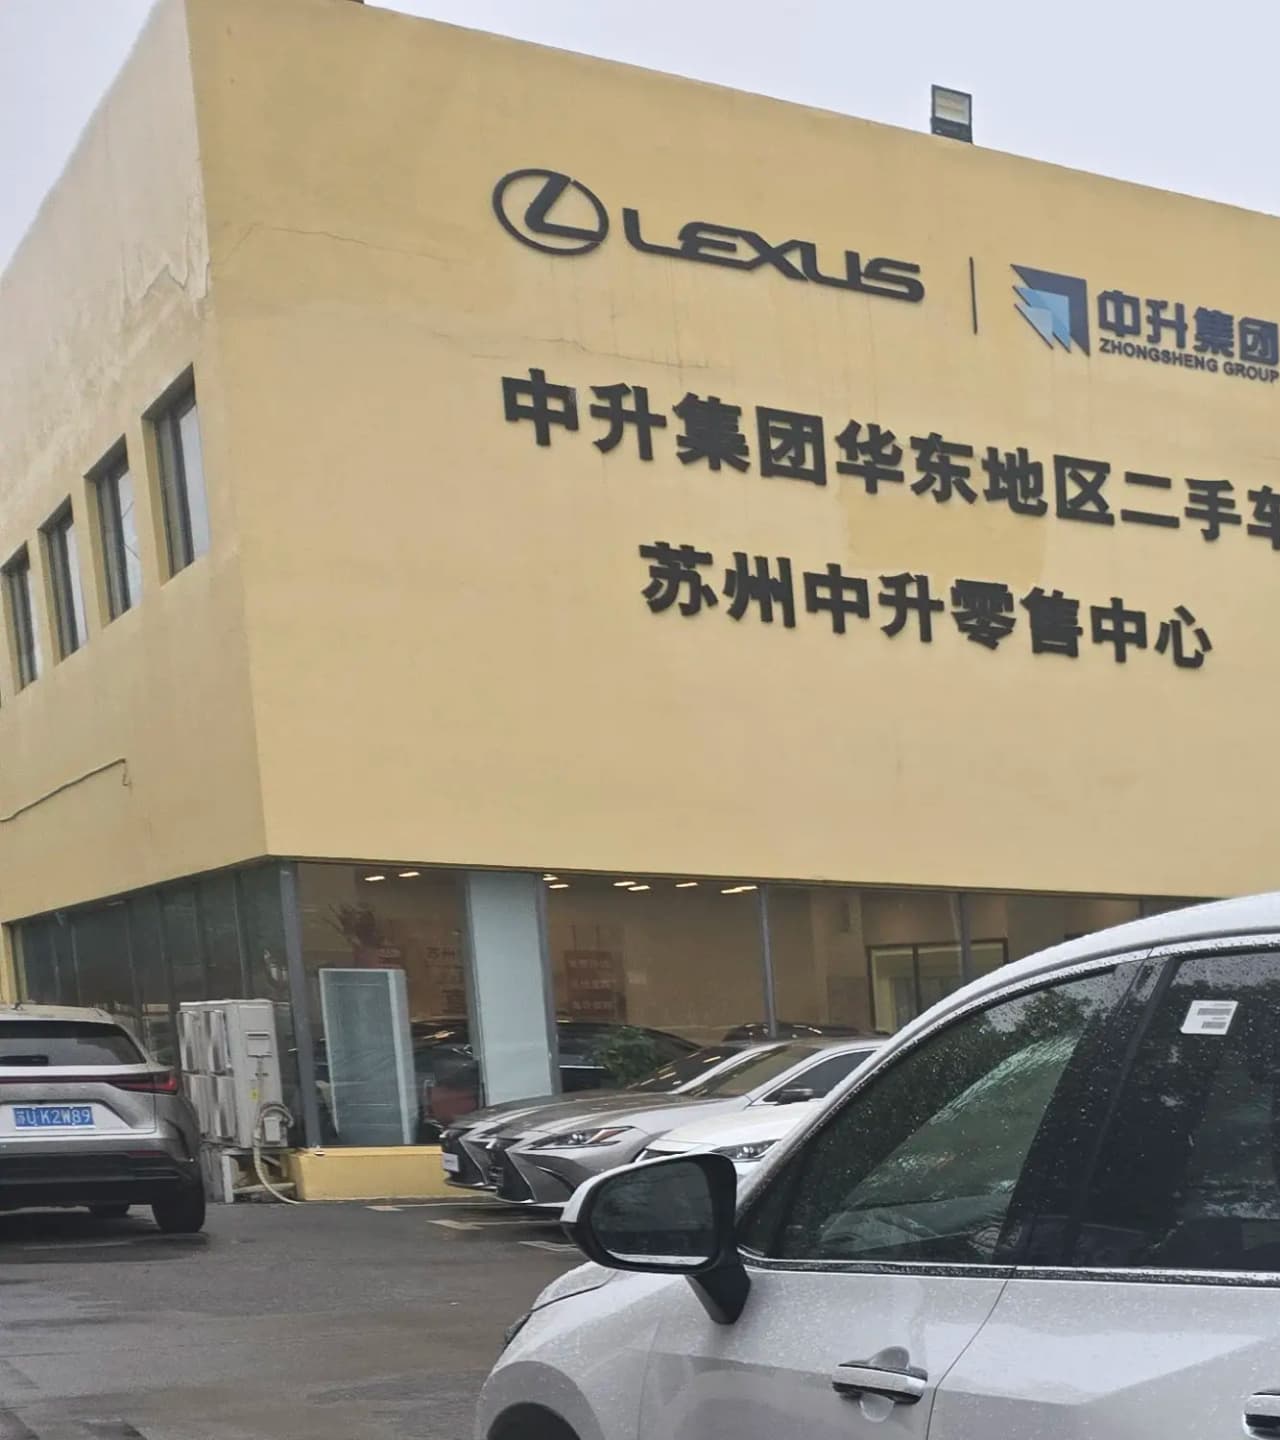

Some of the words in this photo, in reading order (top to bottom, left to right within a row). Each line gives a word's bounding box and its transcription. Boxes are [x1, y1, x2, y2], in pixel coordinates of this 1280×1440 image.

[621, 206, 926, 303] LEXUS
[1097, 289, 1280, 367] 中升集团
[1099, 337, 1219, 374] ZHONGSHENG
[1223, 361, 1280, 384] GROUP
[638, 540, 1213, 669] 苏州中升零售中心
